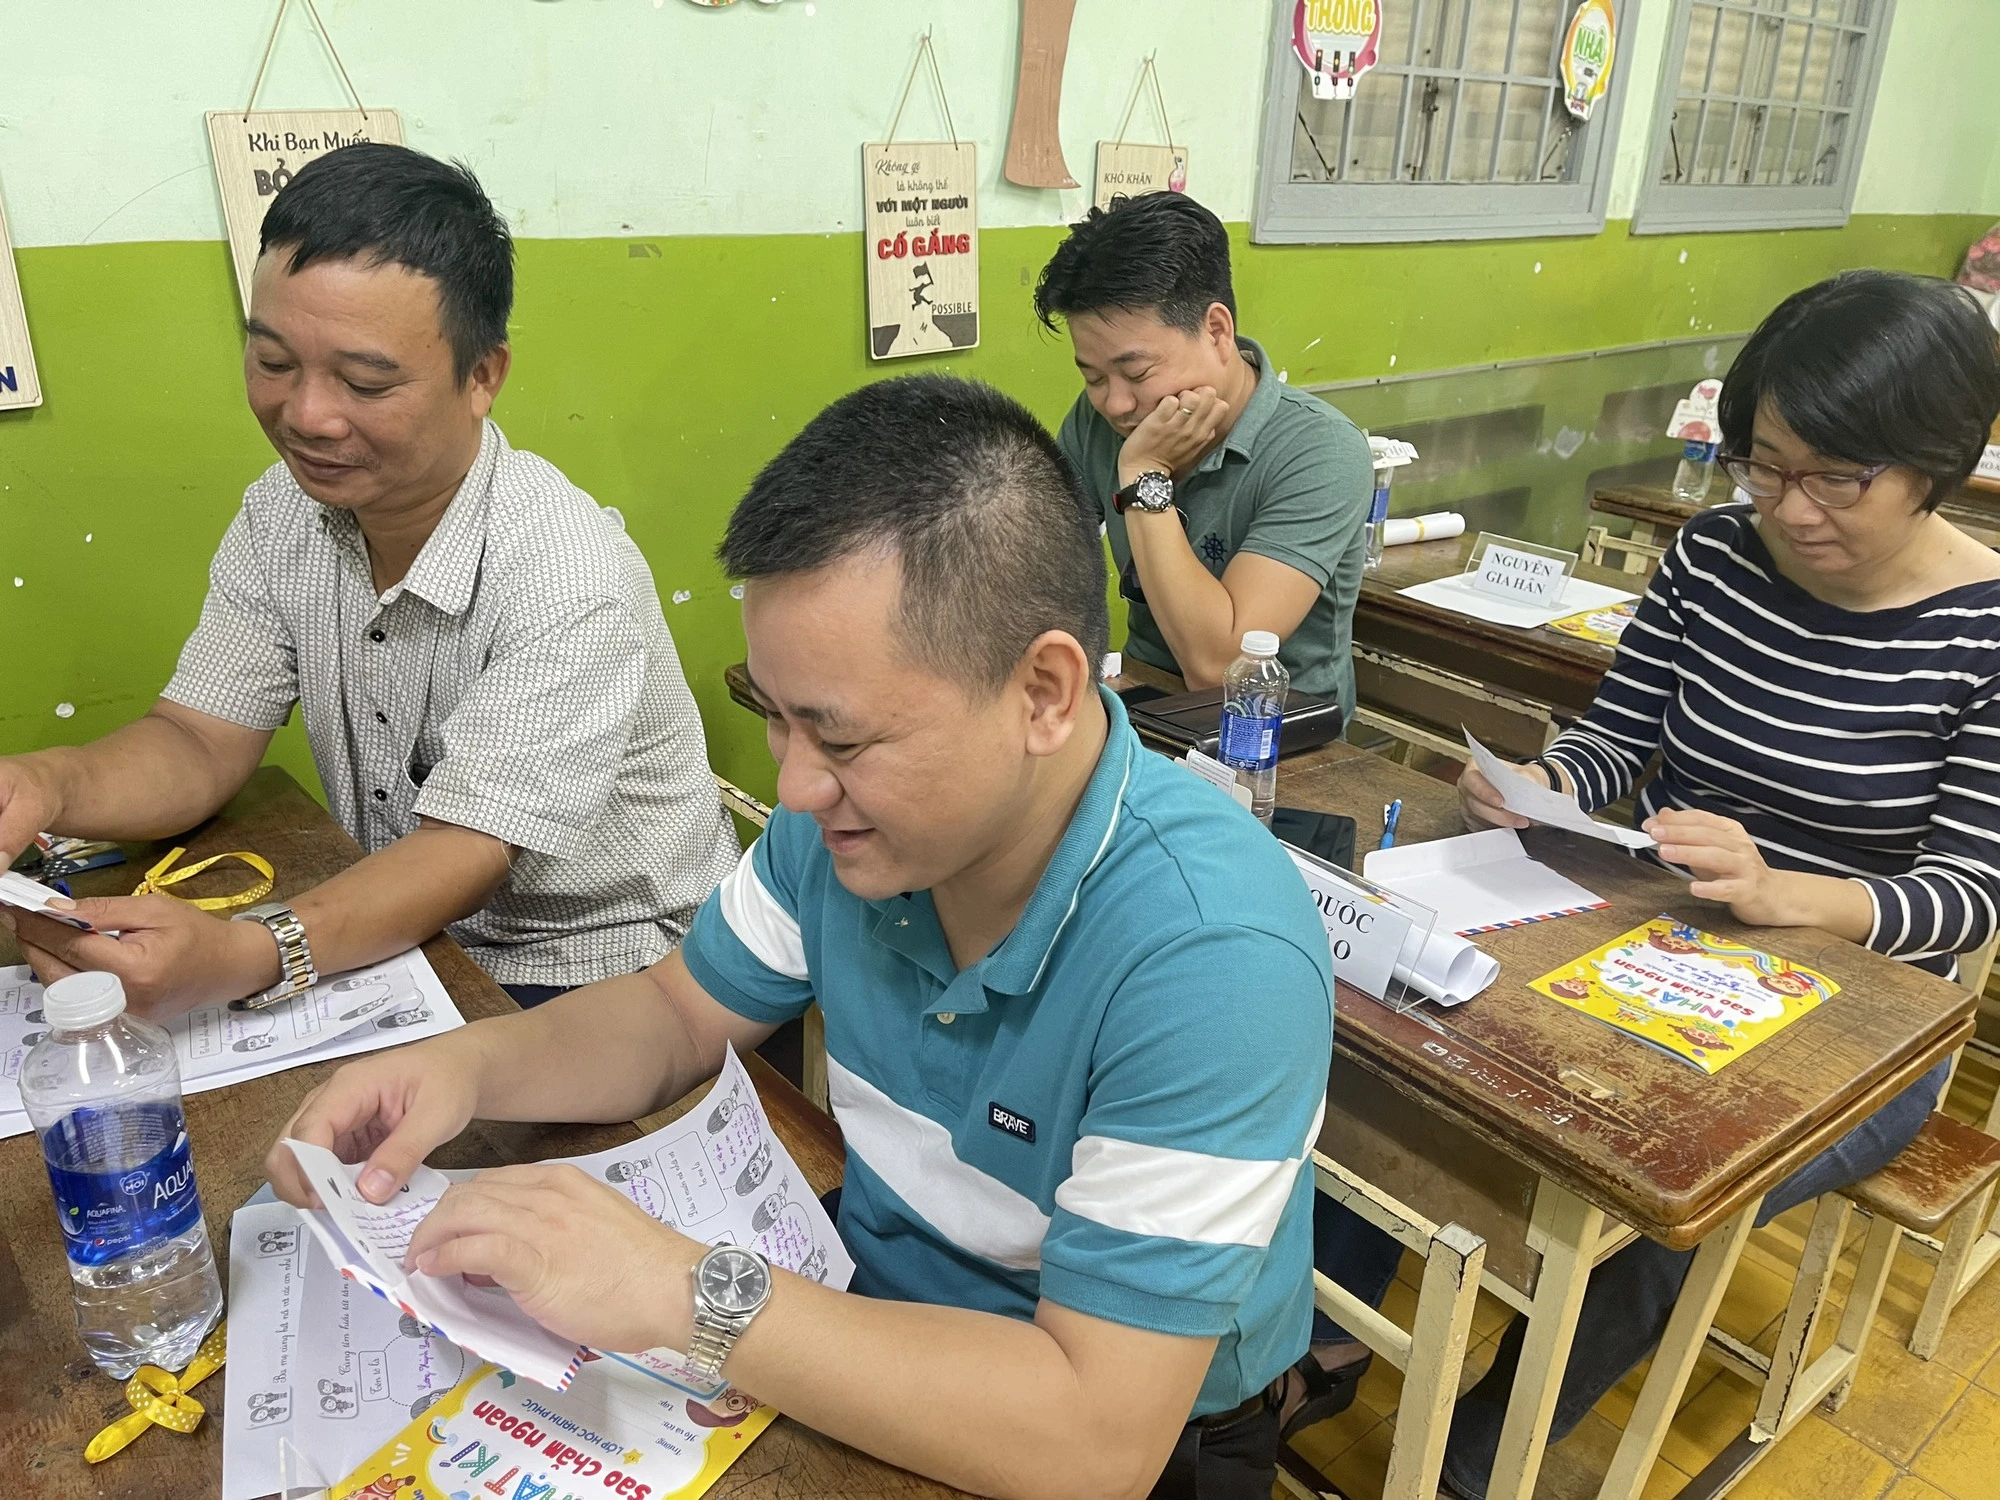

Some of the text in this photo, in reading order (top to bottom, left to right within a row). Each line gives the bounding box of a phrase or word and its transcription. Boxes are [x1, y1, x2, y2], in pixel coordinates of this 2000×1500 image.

[249, 132, 280, 152] Khi
[284, 132, 319, 154] Bạn
[875, 159, 909, 176] Không
[1104, 170, 1153, 185] KHÓ KHĂN
[907, 179, 934, 193] không
[936, 177, 949, 190] thể
[876, 194, 969, 214] VỚI MỘT NGƯỜI
[906, 214, 941, 227] luôn biết
[877, 228, 971, 260] CỐ GẮNG
[931, 302, 972, 314] POSSIBLE
[1491, 553, 1554, 577] NGUYỄN
[1486, 571, 1546, 596] GIA HÂN
[1613, 959, 1668, 983] ngoan
[1669, 981, 1716, 1000] chăm
[1640, 988, 1724, 1019] NHẬT
[1720, 999, 1755, 1016] sao
[993, 1108, 1029, 1134] BRAVE
[87, 1205, 125, 1218] AQUAFINA
[521, 1398, 625, 1456] LỚP HỌC HẠNH PHÚC
[473, 1400, 652, 1500] sao chăm ngoan
